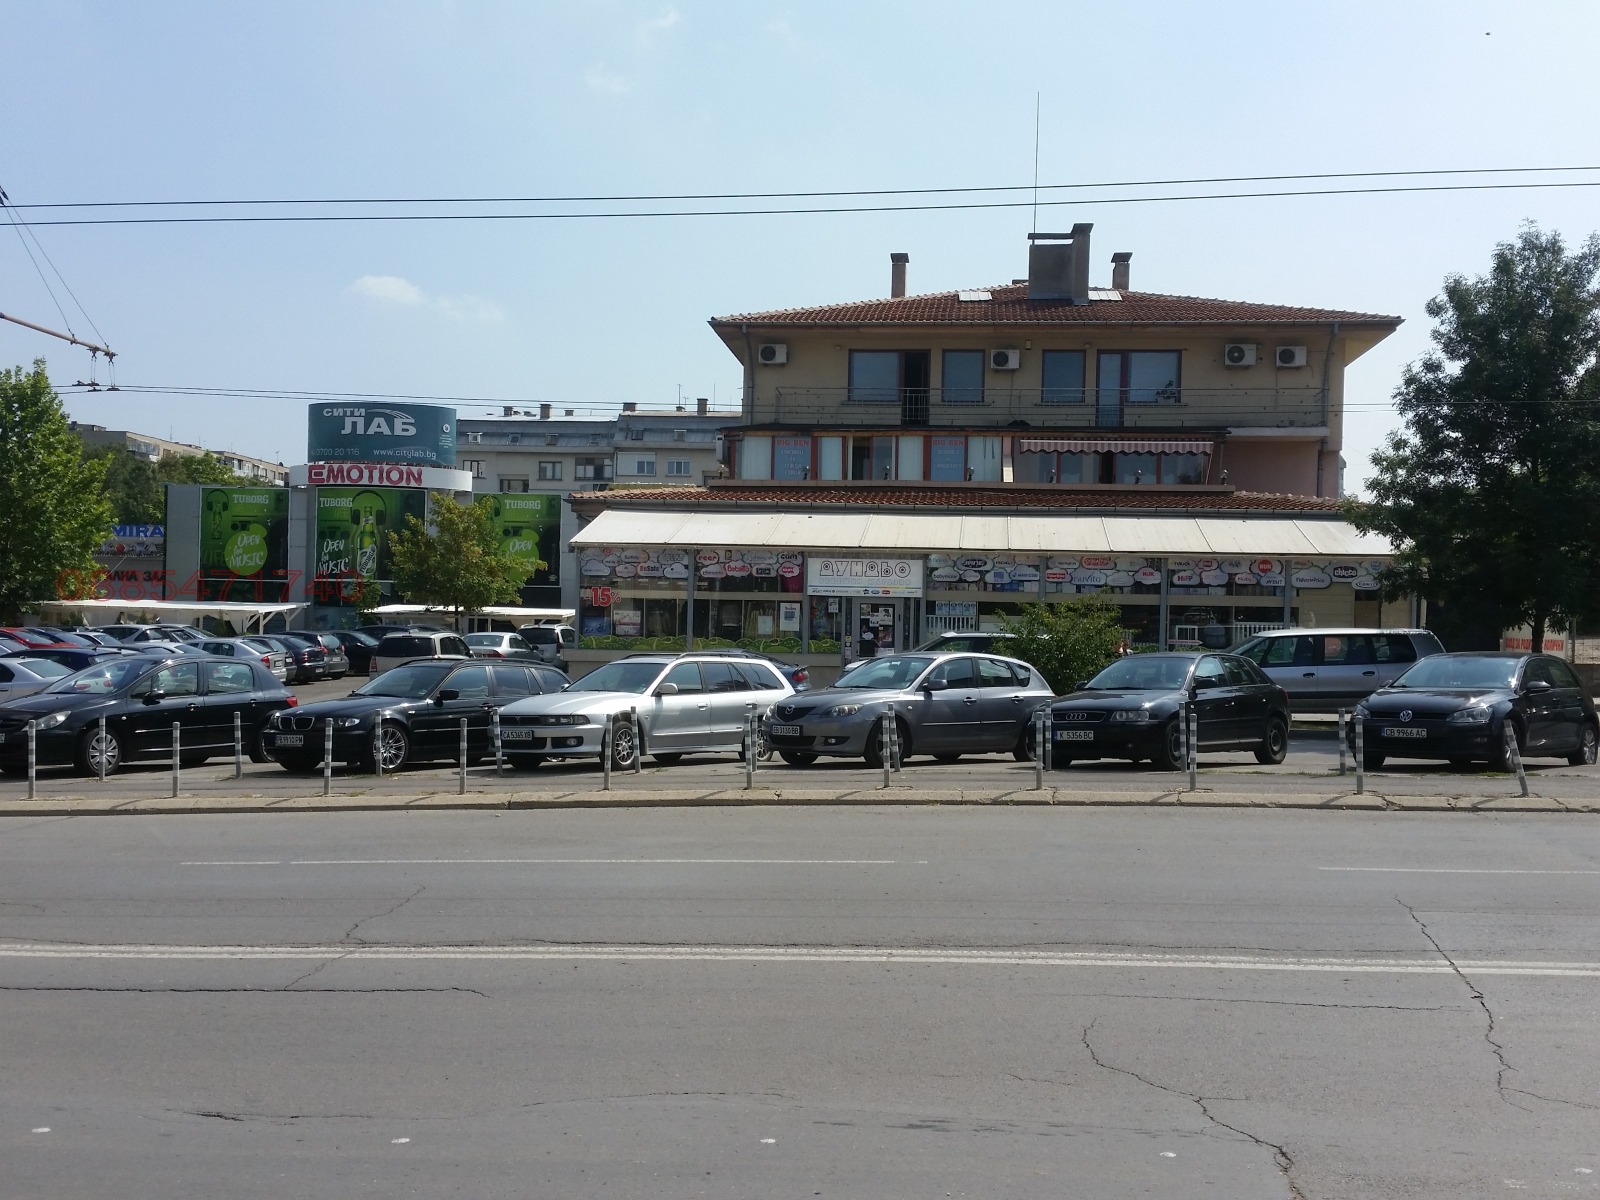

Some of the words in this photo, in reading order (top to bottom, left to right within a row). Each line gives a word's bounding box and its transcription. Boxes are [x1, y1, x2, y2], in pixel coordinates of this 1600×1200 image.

[341, 416, 417, 437] ЛАБ
[335, 448, 344, 456] 20
[373, 449, 437, 460] www.citylab.bg
[308, 464, 422, 487] EMOTION
[232, 494, 269, 504] TUBORG
[319, 497, 353, 508] TUBORG
[504, 499, 541, 510] TUBORG
[1334, 569, 1357, 577] chicco
